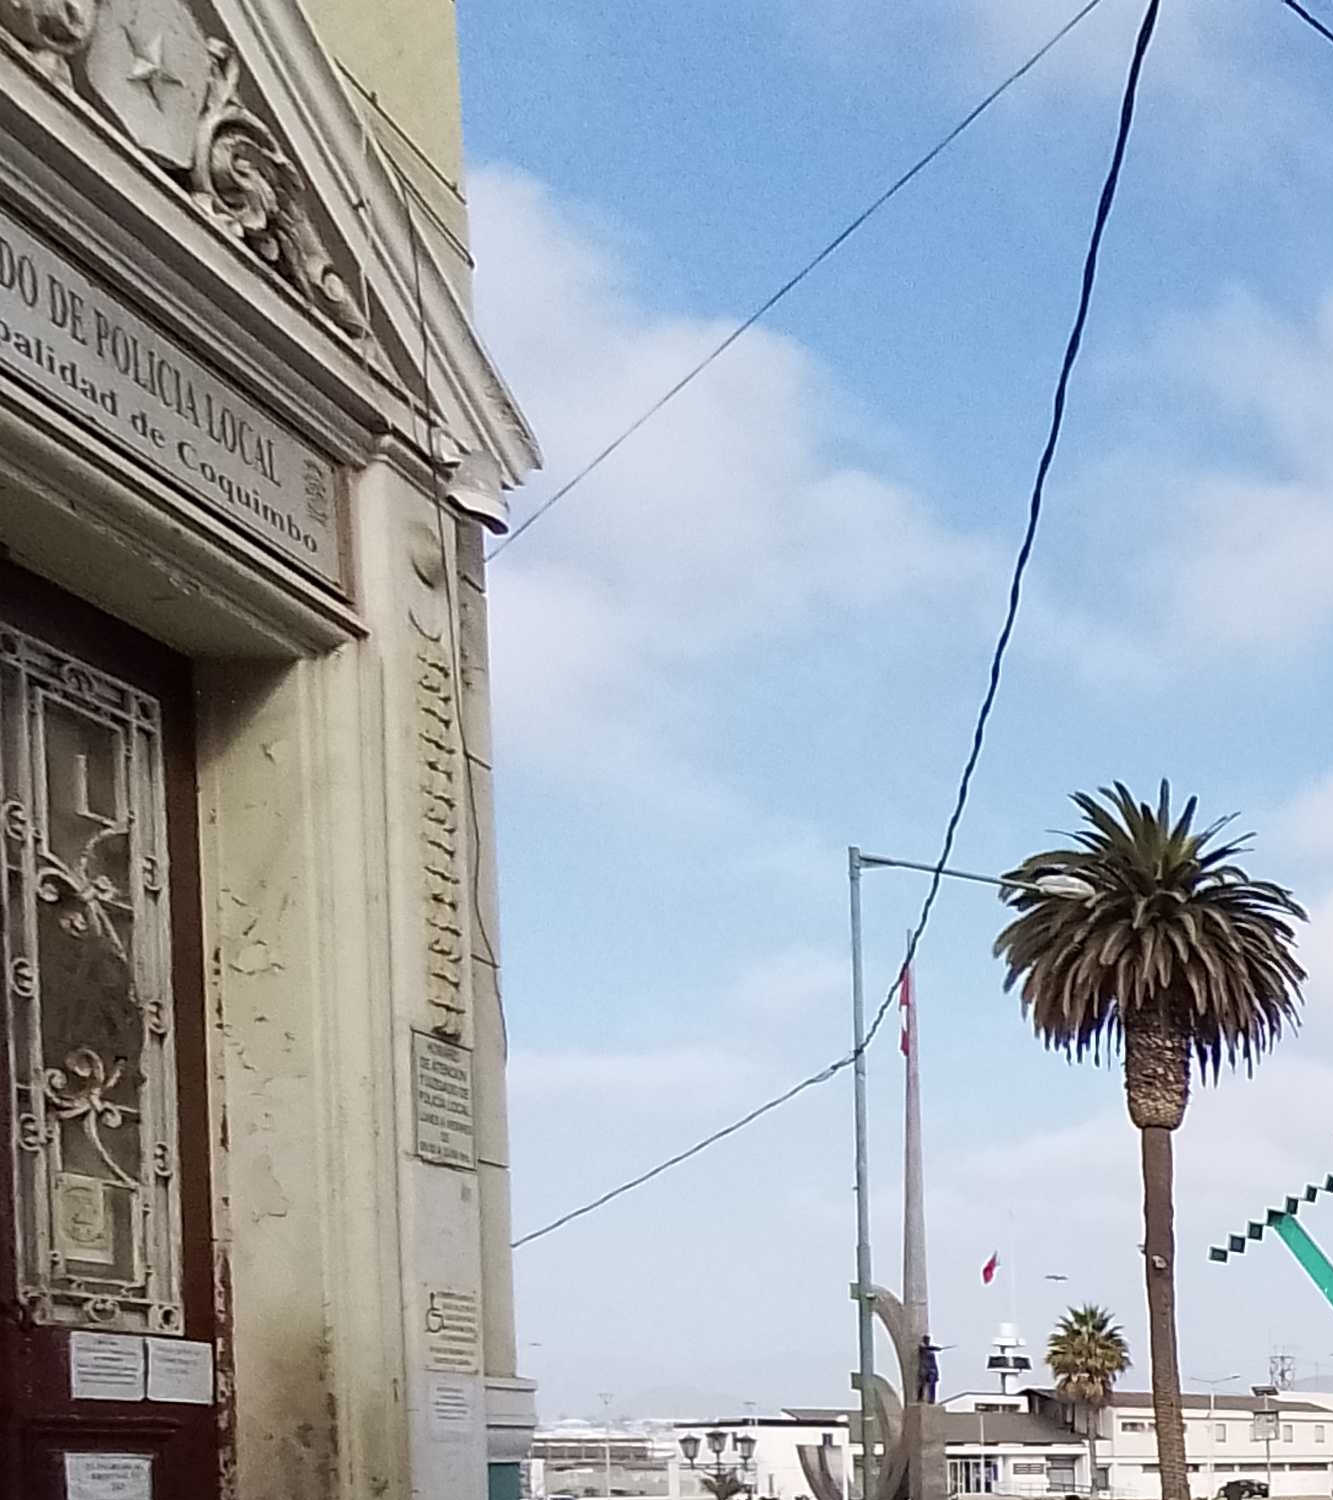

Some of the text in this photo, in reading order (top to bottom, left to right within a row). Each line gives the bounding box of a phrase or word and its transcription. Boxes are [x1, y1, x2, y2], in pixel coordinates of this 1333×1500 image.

[48, 274, 88, 346] DE
[206, 393, 281, 488] LOCAL
[131, 411, 165, 448] de
[178, 442, 317, 552] Coquimbo
